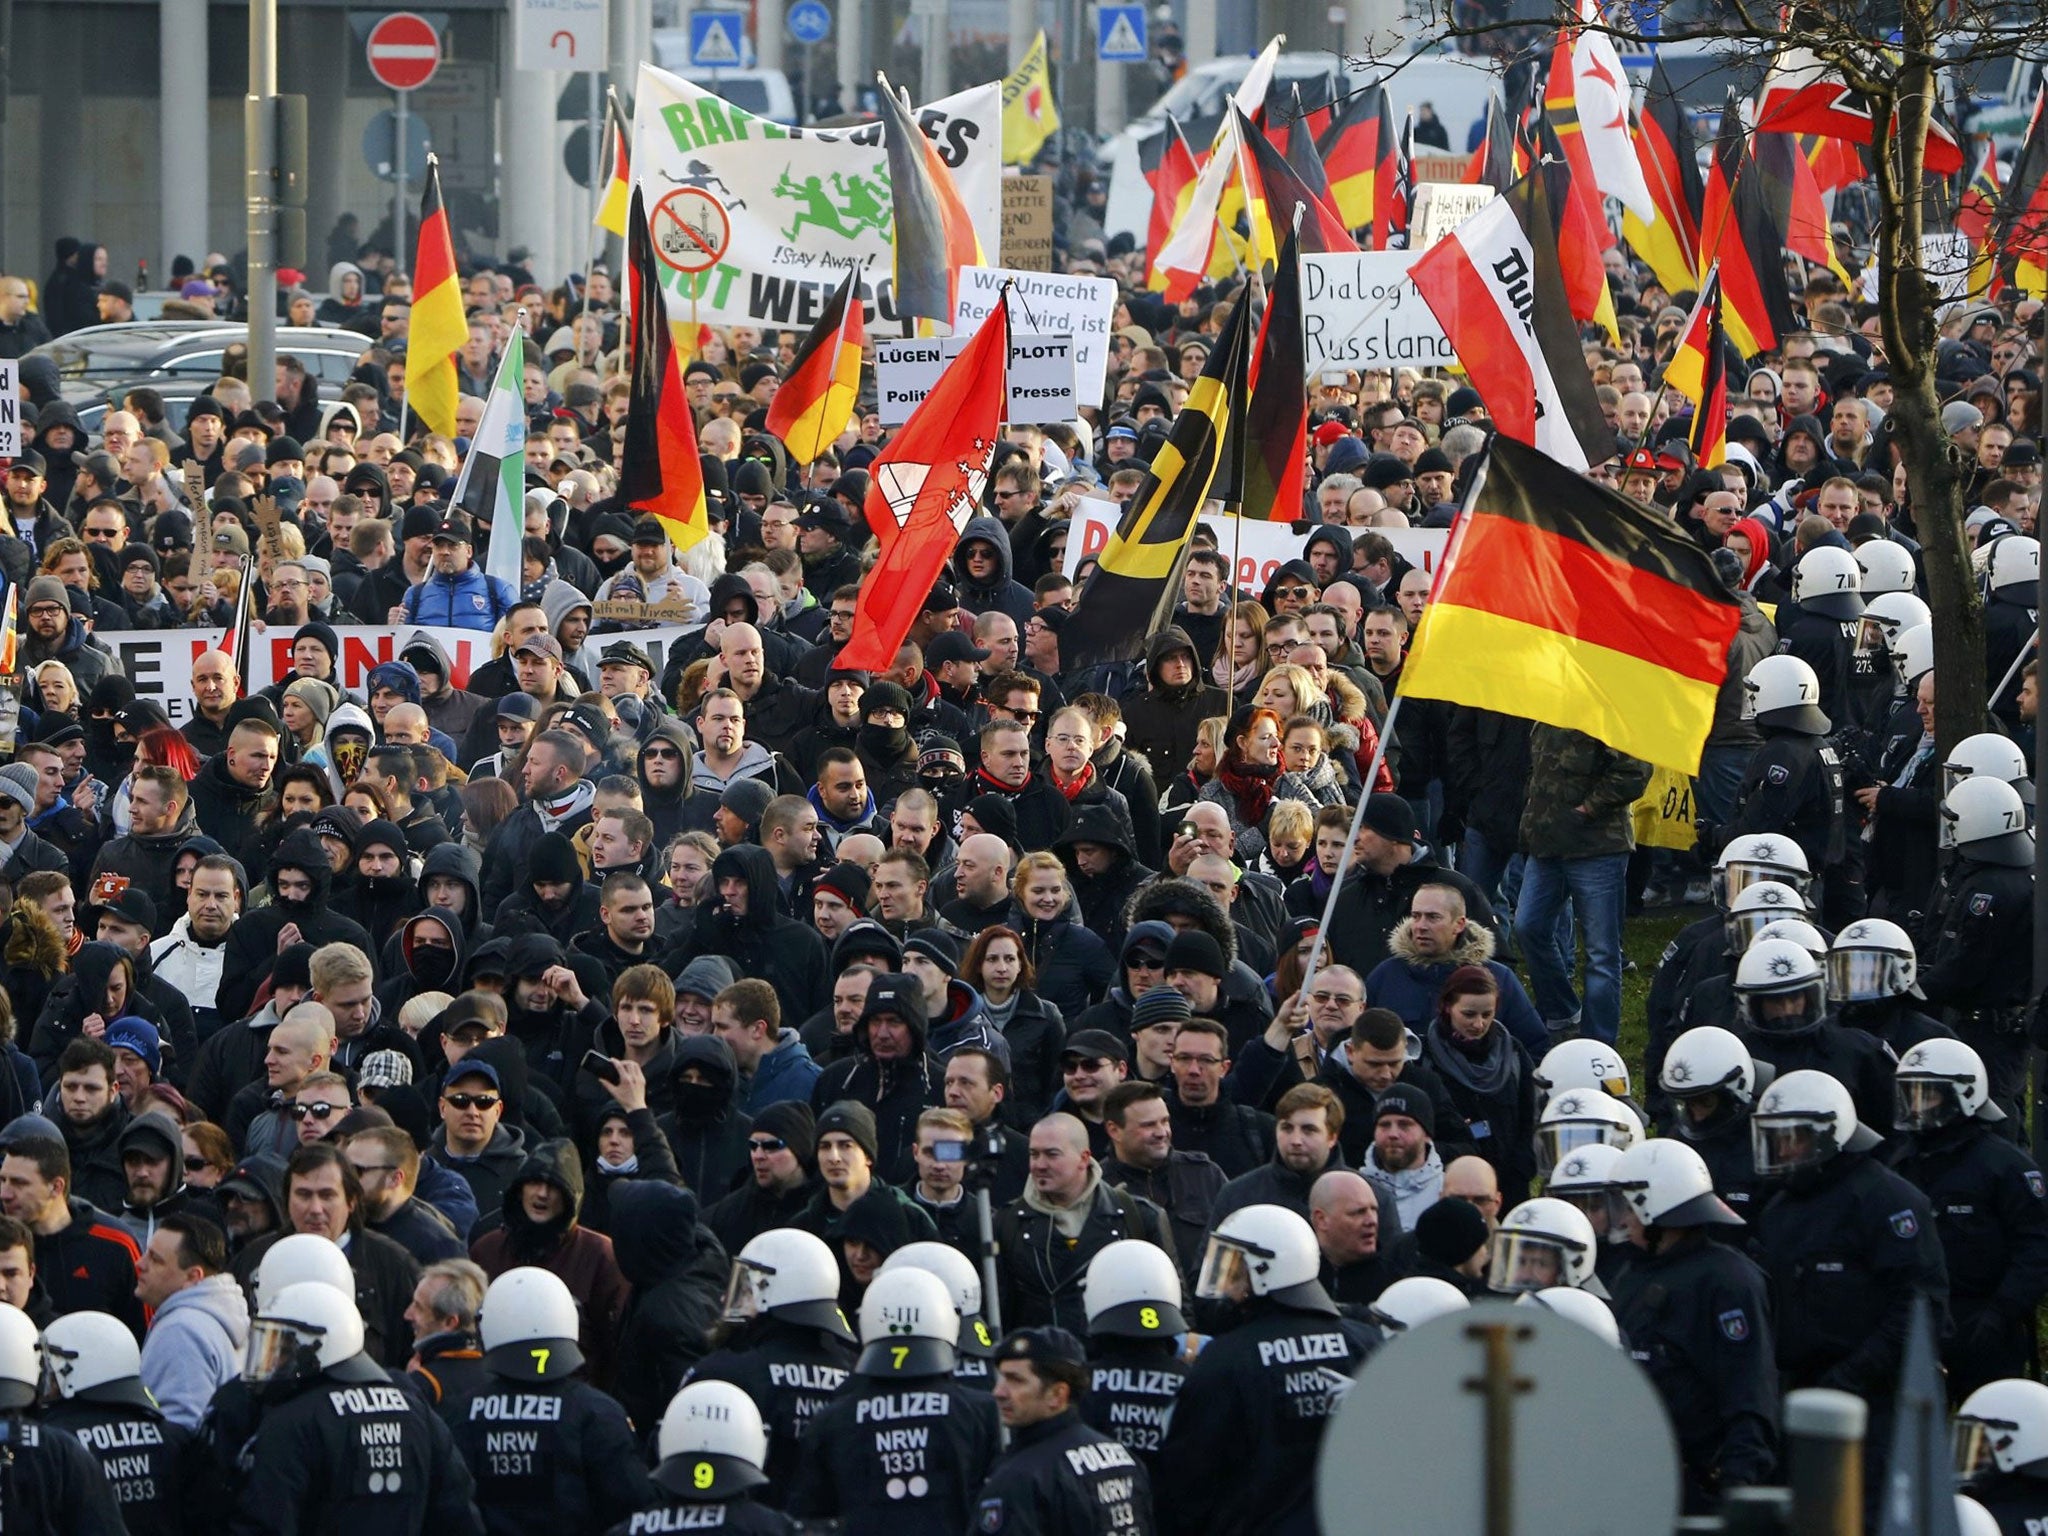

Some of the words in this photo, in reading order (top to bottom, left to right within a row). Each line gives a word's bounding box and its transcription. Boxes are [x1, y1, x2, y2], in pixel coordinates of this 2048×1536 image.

[1016, 276, 1098, 302] Unrecht
[1305, 259, 1402, 311] Dialog
[1081, 314, 1106, 333] ist
[879, 349, 940, 364] LÜGEN
[1012, 386, 1071, 399] Presse
[1140, 1307, 1160, 1329] 8
[530, 1348, 550, 1374] 7
[890, 1346, 910, 1370] 7
[1258, 1332, 1349, 1367] POLIZEI
[328, 1387, 410, 1416] POLIZEI
[469, 1394, 562, 1421] POLIZEI
[856, 1391, 950, 1424] POLIZEI
[1110, 1403, 1162, 1427] NRW
[76, 1421, 164, 1451] POLIZEI
[360, 1422, 402, 1446] NRW
[486, 1431, 538, 1453] NRW
[875, 1426, 929, 1452] NRW
[103, 1453, 150, 1480] NRW
[367, 1446, 403, 1469] 1331
[489, 1454, 532, 1475] 1331
[880, 1449, 925, 1475] 1331
[1065, 1442, 1136, 1475] POLIZEI
[693, 1462, 714, 1489] 9
[113, 1479, 156, 1503] 1333
[629, 1504, 727, 1536] POLIZEI
